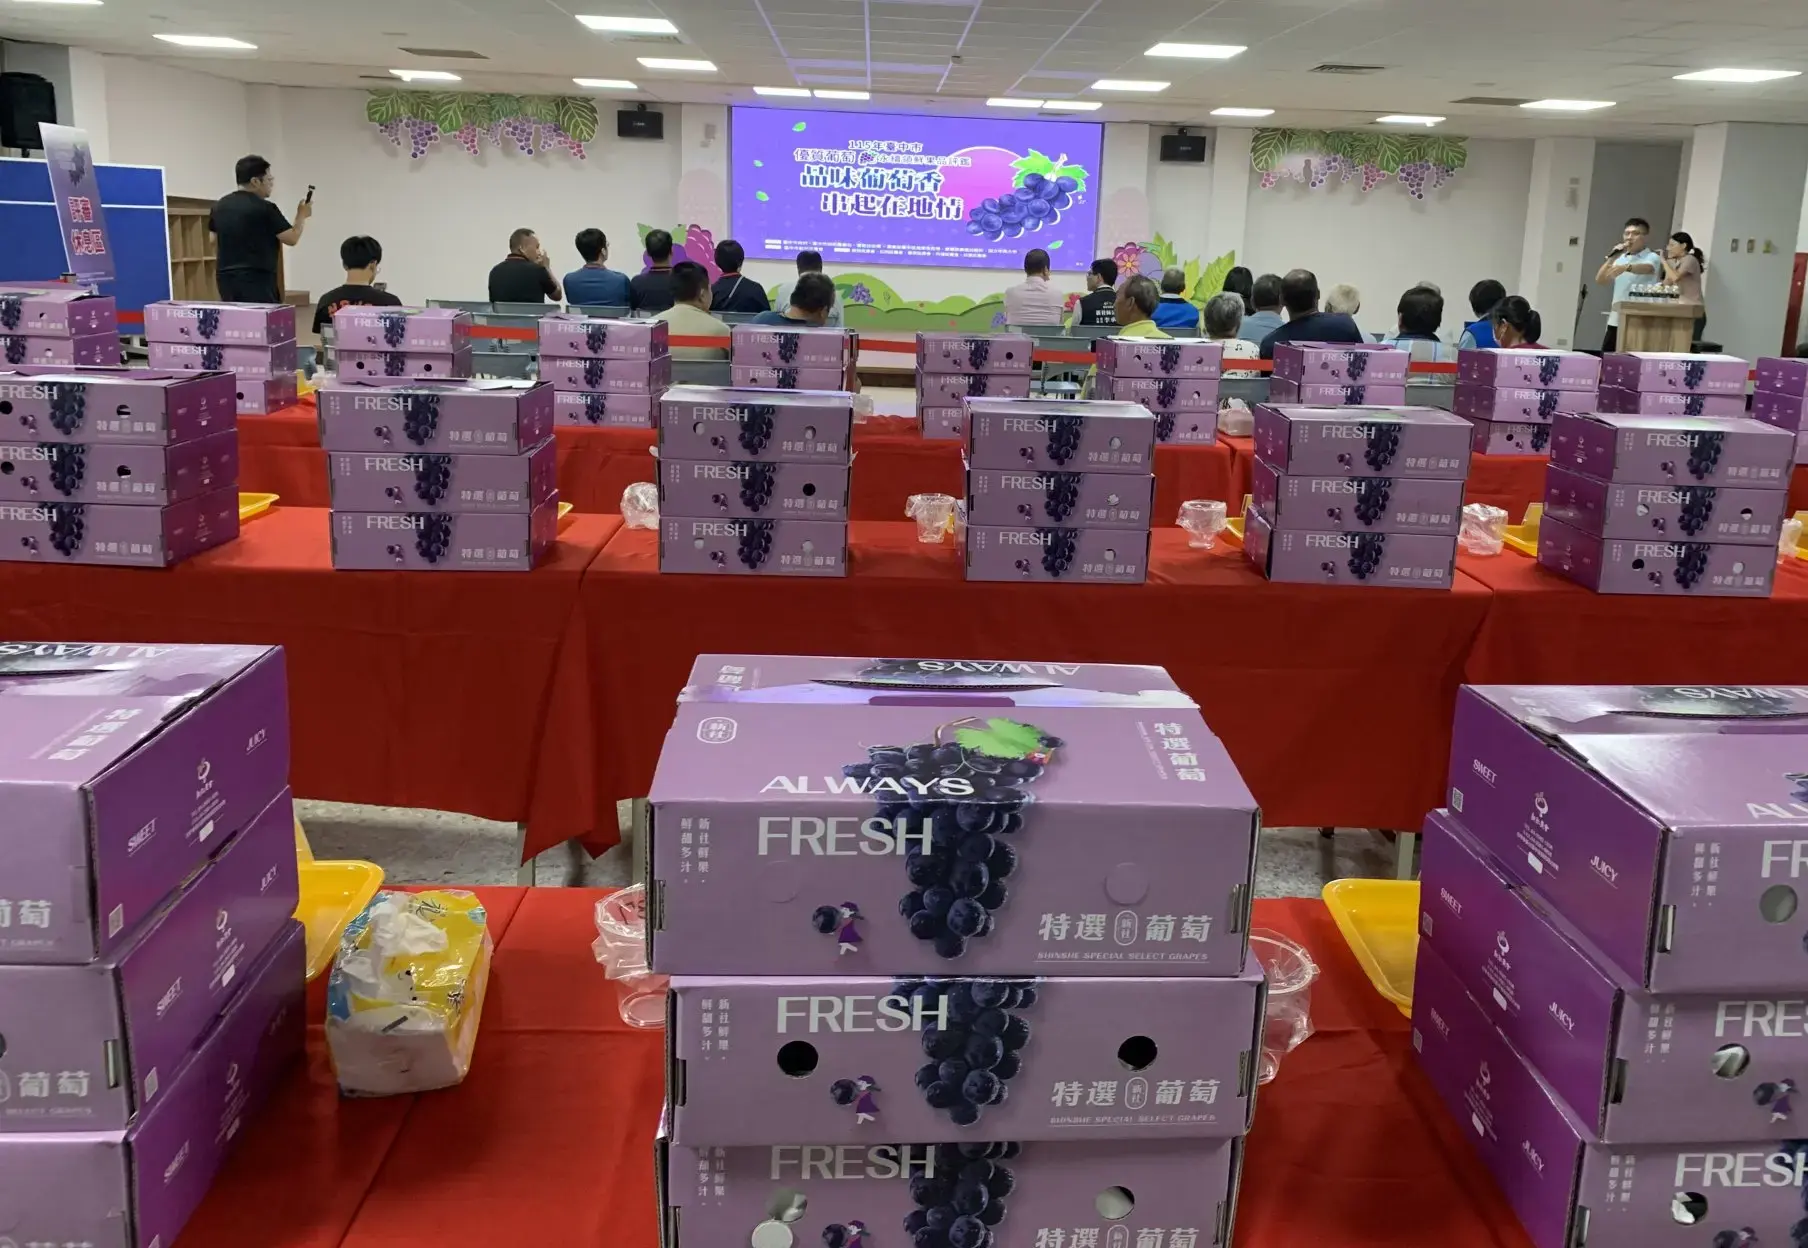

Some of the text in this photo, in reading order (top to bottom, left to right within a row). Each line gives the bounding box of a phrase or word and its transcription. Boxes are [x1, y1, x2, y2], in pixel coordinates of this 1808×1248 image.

[848, 140, 923, 152] 115年臺中市
[794, 148, 856, 163] 優質葡萄
[800, 165, 945, 192] 品味葡萄香
[821, 192, 963, 220] 串起在地情
[166, 309, 203, 319] FRESH
[354, 317, 390, 328] FRESH
[557, 324, 592, 334] FRESH
[750, 335, 784, 344] FRESH
[942, 341, 975, 351] FRESH
[171, 346, 207, 355] FRESH
[1134, 345, 1166, 355] FRESH
[1322, 352, 1354, 362] FRESH
[556, 359, 589, 369] FRESH
[1514, 357, 1546, 366] FRESH
[749, 370, 783, 379] FRESH
[940, 375, 973, 385] FRESH
[1131, 380, 1164, 389] FRESH
[1319, 387, 1350, 396] FRESH
[0, 385, 58, 400] FRESH
[557, 394, 591, 404] FRESH
[1513, 391, 1545, 400] FRESH
[354, 396, 412, 411] FRESH
[692, 407, 749, 422] FRESH
[1003, 418, 1057, 433] FRESH
[1322, 425, 1376, 440] FRESH
[1646, 434, 1699, 448] FRESH
[0, 446, 58, 461] FRESH
[364, 457, 423, 472] FRESH
[694, 465, 749, 479] FRESH
[1001, 475, 1055, 490] FRESH
[1311, 479, 1366, 494] FRESH
[1638, 490, 1690, 504] FRESH
[0, 507, 57, 522] FRESH
[366, 515, 425, 530] FRESH
[692, 522, 748, 537] FRESH
[999, 531, 1052, 546] FRESH
[1305, 534, 1360, 549] FRESH
[1633, 544, 1686, 559] FRESH
[917, 660, 1081, 676] ALWAYS
[246, 728, 267, 752] JUICY
[1154, 722, 1206, 782] 特選葡萄
[1473, 759, 1497, 784] SWEET
[759, 775, 975, 796] ALWAYS
[127, 819, 157, 853] SWEET
[757, 816, 933, 856] FRESH
[1590, 855, 1619, 882] JUICY
[260, 864, 278, 891] JUICY
[1440, 888, 1463, 914] SWEET
[1038, 913, 1107, 942] 特選
[1145, 914, 1213, 942] 葡萄
[1083, 952, 1124, 960] SPECIAL
[776, 994, 949, 1034] FRESH
[1549, 1001, 1576, 1031] JUICY
[1715, 1000, 1808, 1037] FRE
[17, 1070, 90, 1098] 葡萄
[1051, 1080, 1118, 1107] 特選
[1154, 1079, 1221, 1105] 葡萄
[770, 1145, 936, 1180] FRESH
[1522, 1139, 1546, 1172] JUICY
[1035, 1227, 1100, 1248] 特選
[1136, 1227, 1200, 1248] 葡萄
